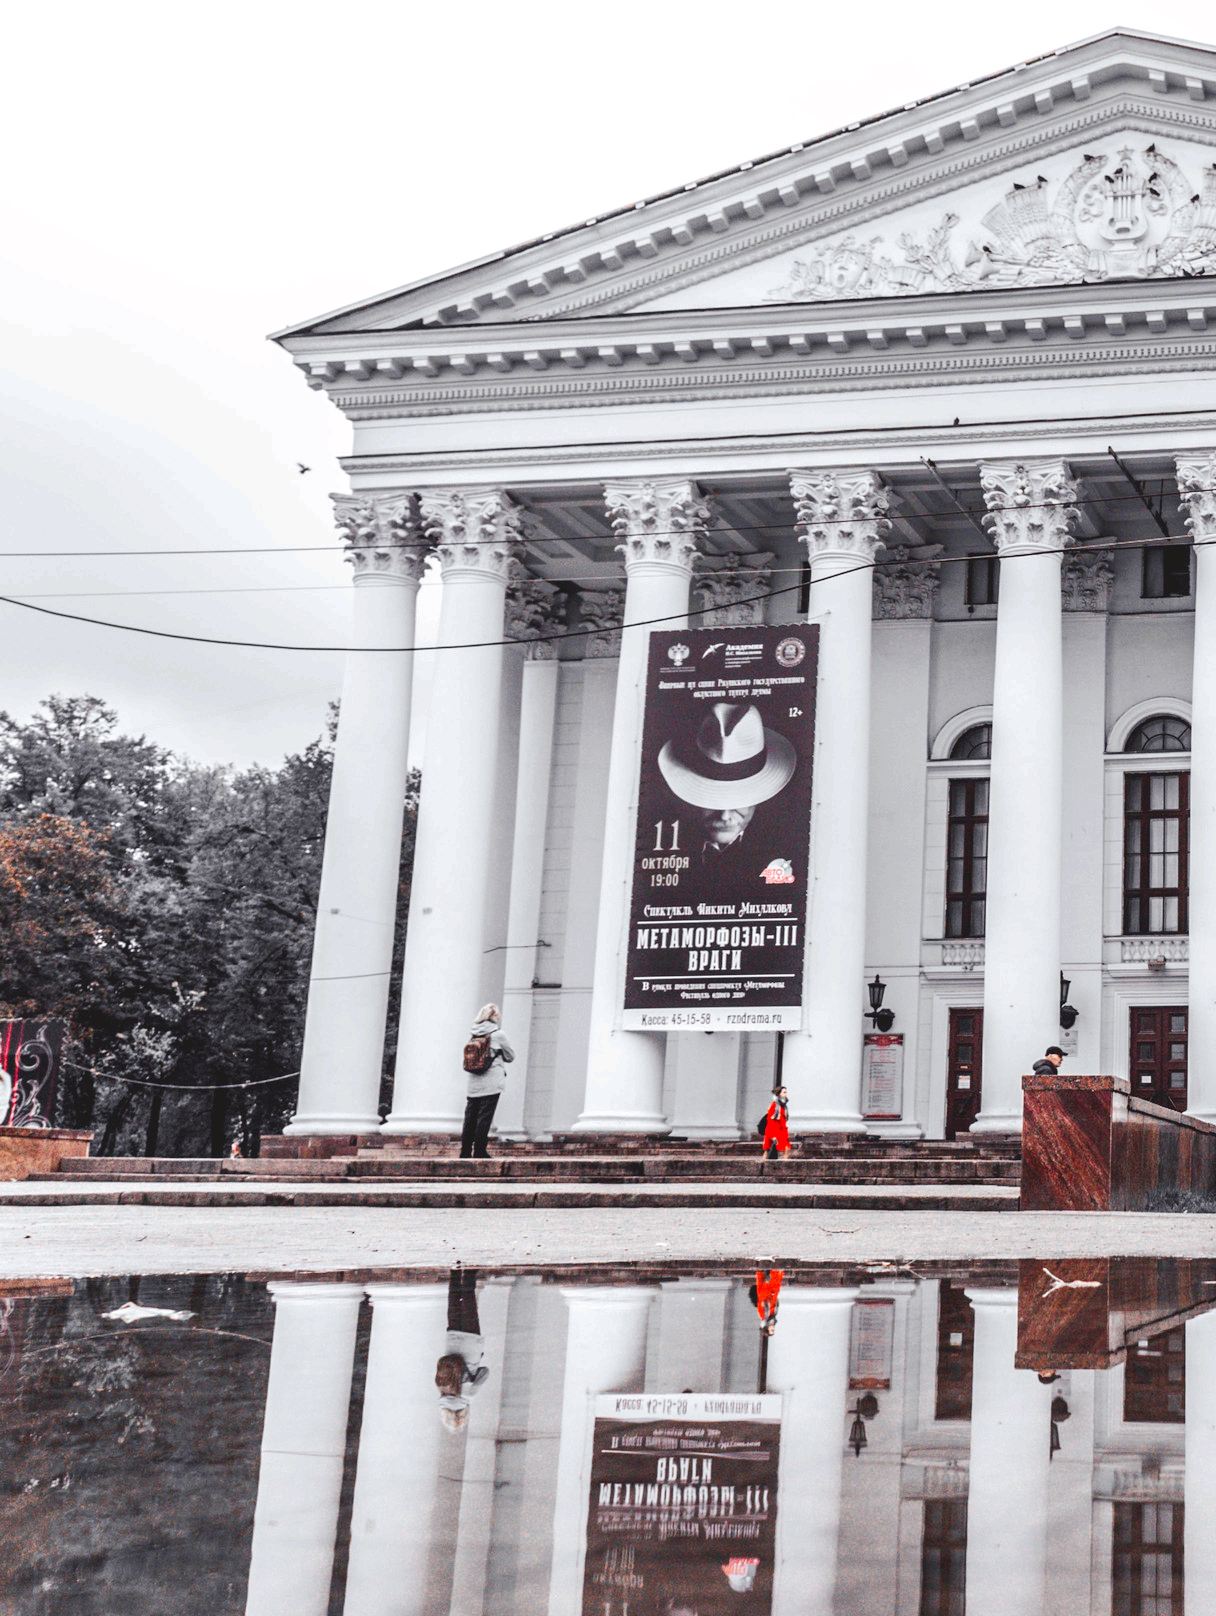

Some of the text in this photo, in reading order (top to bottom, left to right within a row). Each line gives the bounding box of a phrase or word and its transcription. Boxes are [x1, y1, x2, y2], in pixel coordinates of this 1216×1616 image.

[788, 707, 803, 718] 12+
[652, 820, 680, 851] 11
[641, 855, 690, 872] октября
[650, 873, 679, 888] 19:00
[636, 925, 798, 950] МЕТАМОРФОЗЫ-III
[688, 950, 742, 972] ВРАГИ
[642, 982, 650, 991] В
[641, 1012, 782, 1025] Касса: 45-15-58 rzndrama.ru
